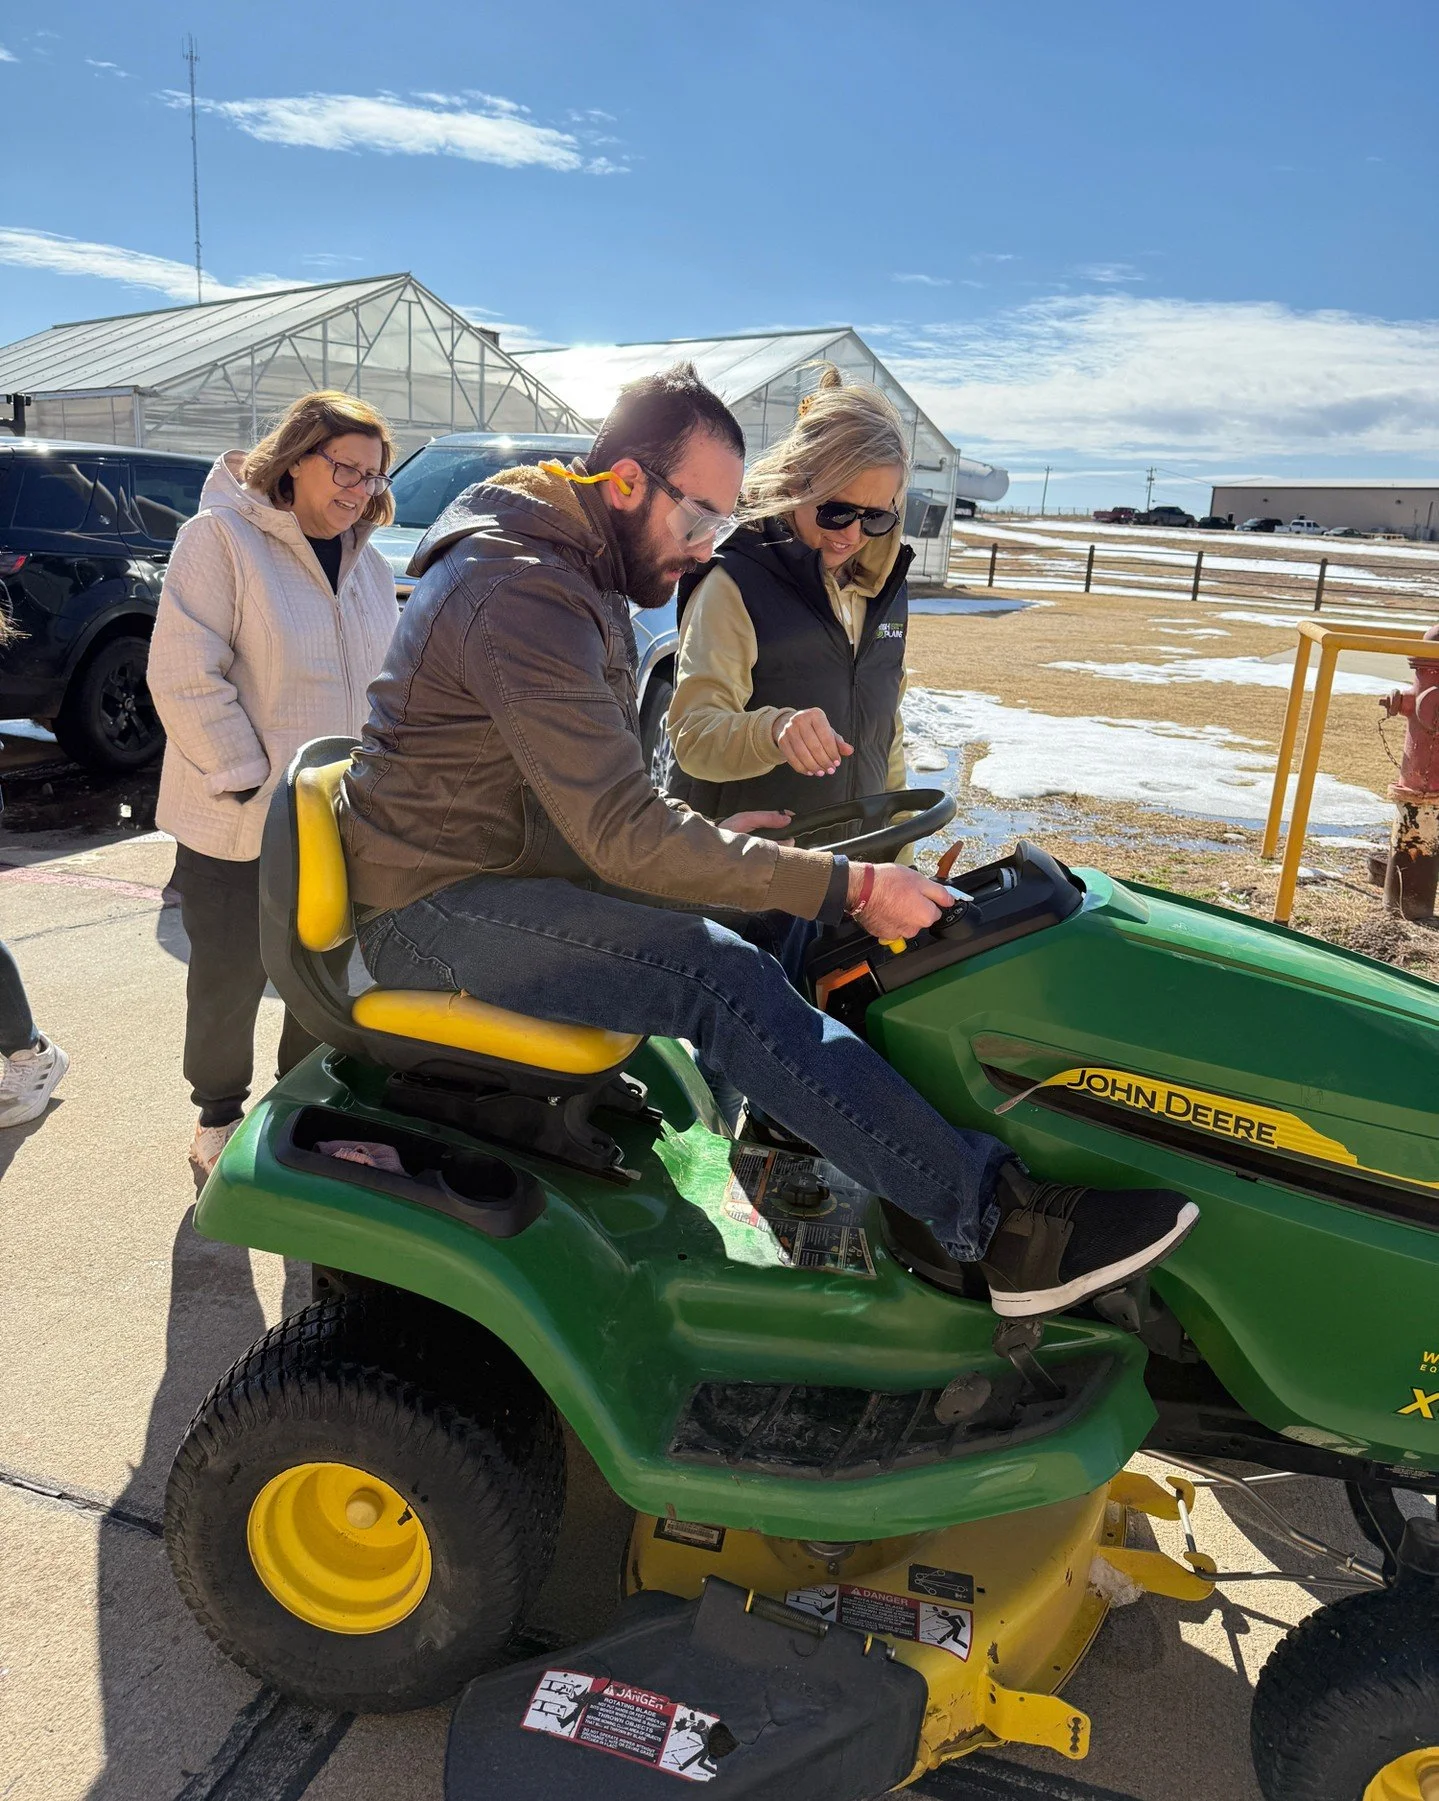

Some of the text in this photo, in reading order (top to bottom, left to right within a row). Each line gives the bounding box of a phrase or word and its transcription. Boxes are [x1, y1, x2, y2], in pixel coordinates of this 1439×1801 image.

[1067, 1069, 1278, 1148] JOHN DEERE
[863, 1590, 908, 1605] DANGER
[635, 1706, 657, 1717] BLADE
[624, 1720, 654, 1733] OBJECTS
